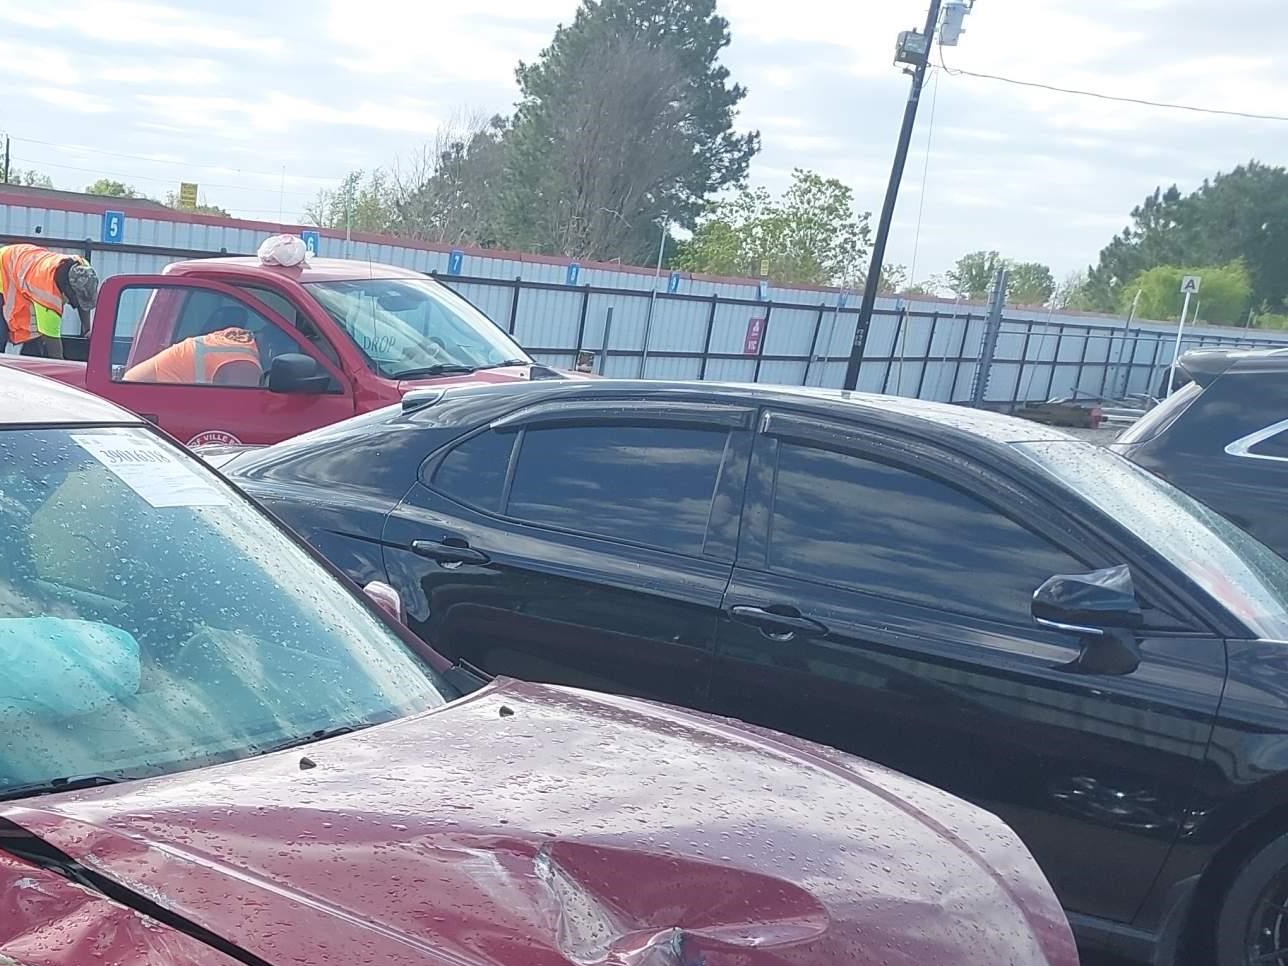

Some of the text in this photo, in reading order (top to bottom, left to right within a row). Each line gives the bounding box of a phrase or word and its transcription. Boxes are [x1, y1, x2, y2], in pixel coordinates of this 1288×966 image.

[110, 217, 118, 237] 5
[453, 255, 460, 271] 7
[1184, 279, 1197, 290] A
[363, 335, 397, 353] DROP
[203, 433, 229, 443] VILLE
